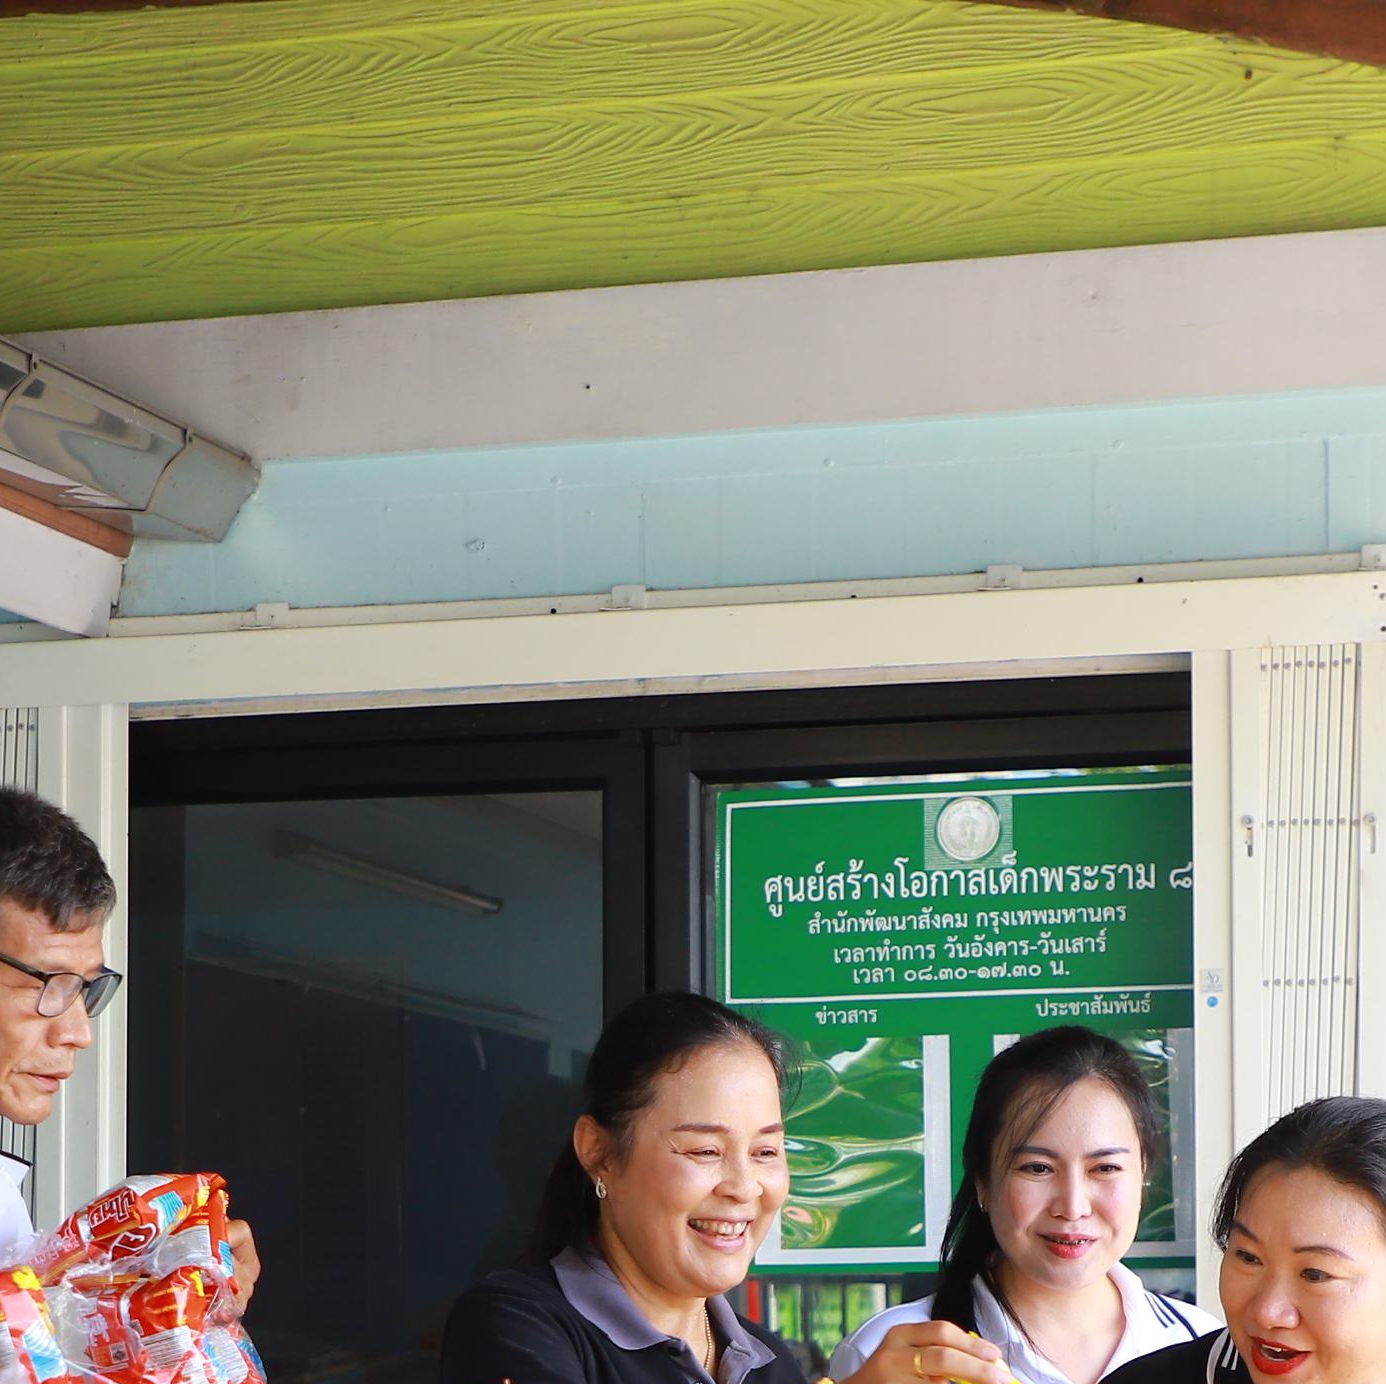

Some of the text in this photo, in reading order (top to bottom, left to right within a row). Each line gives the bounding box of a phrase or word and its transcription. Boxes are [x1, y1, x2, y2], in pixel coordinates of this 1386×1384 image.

[764, 850, 1156, 917] ศูนย์สร้างโอกาสเด็กพระราม
[808, 905, 1127, 936] สำนักพัฒนาสังคม กรุงเทพมหานคร
[834, 928, 1108, 964] เวลาทำการ วันอังคาร-วันเสาร์
[853, 959, 1071, 985] เวลา ๐๘.๓๐-๑๗.๓๐ น.
[816, 992, 1152, 1025] ข่าวสาร ประชาสัมพันธ์
